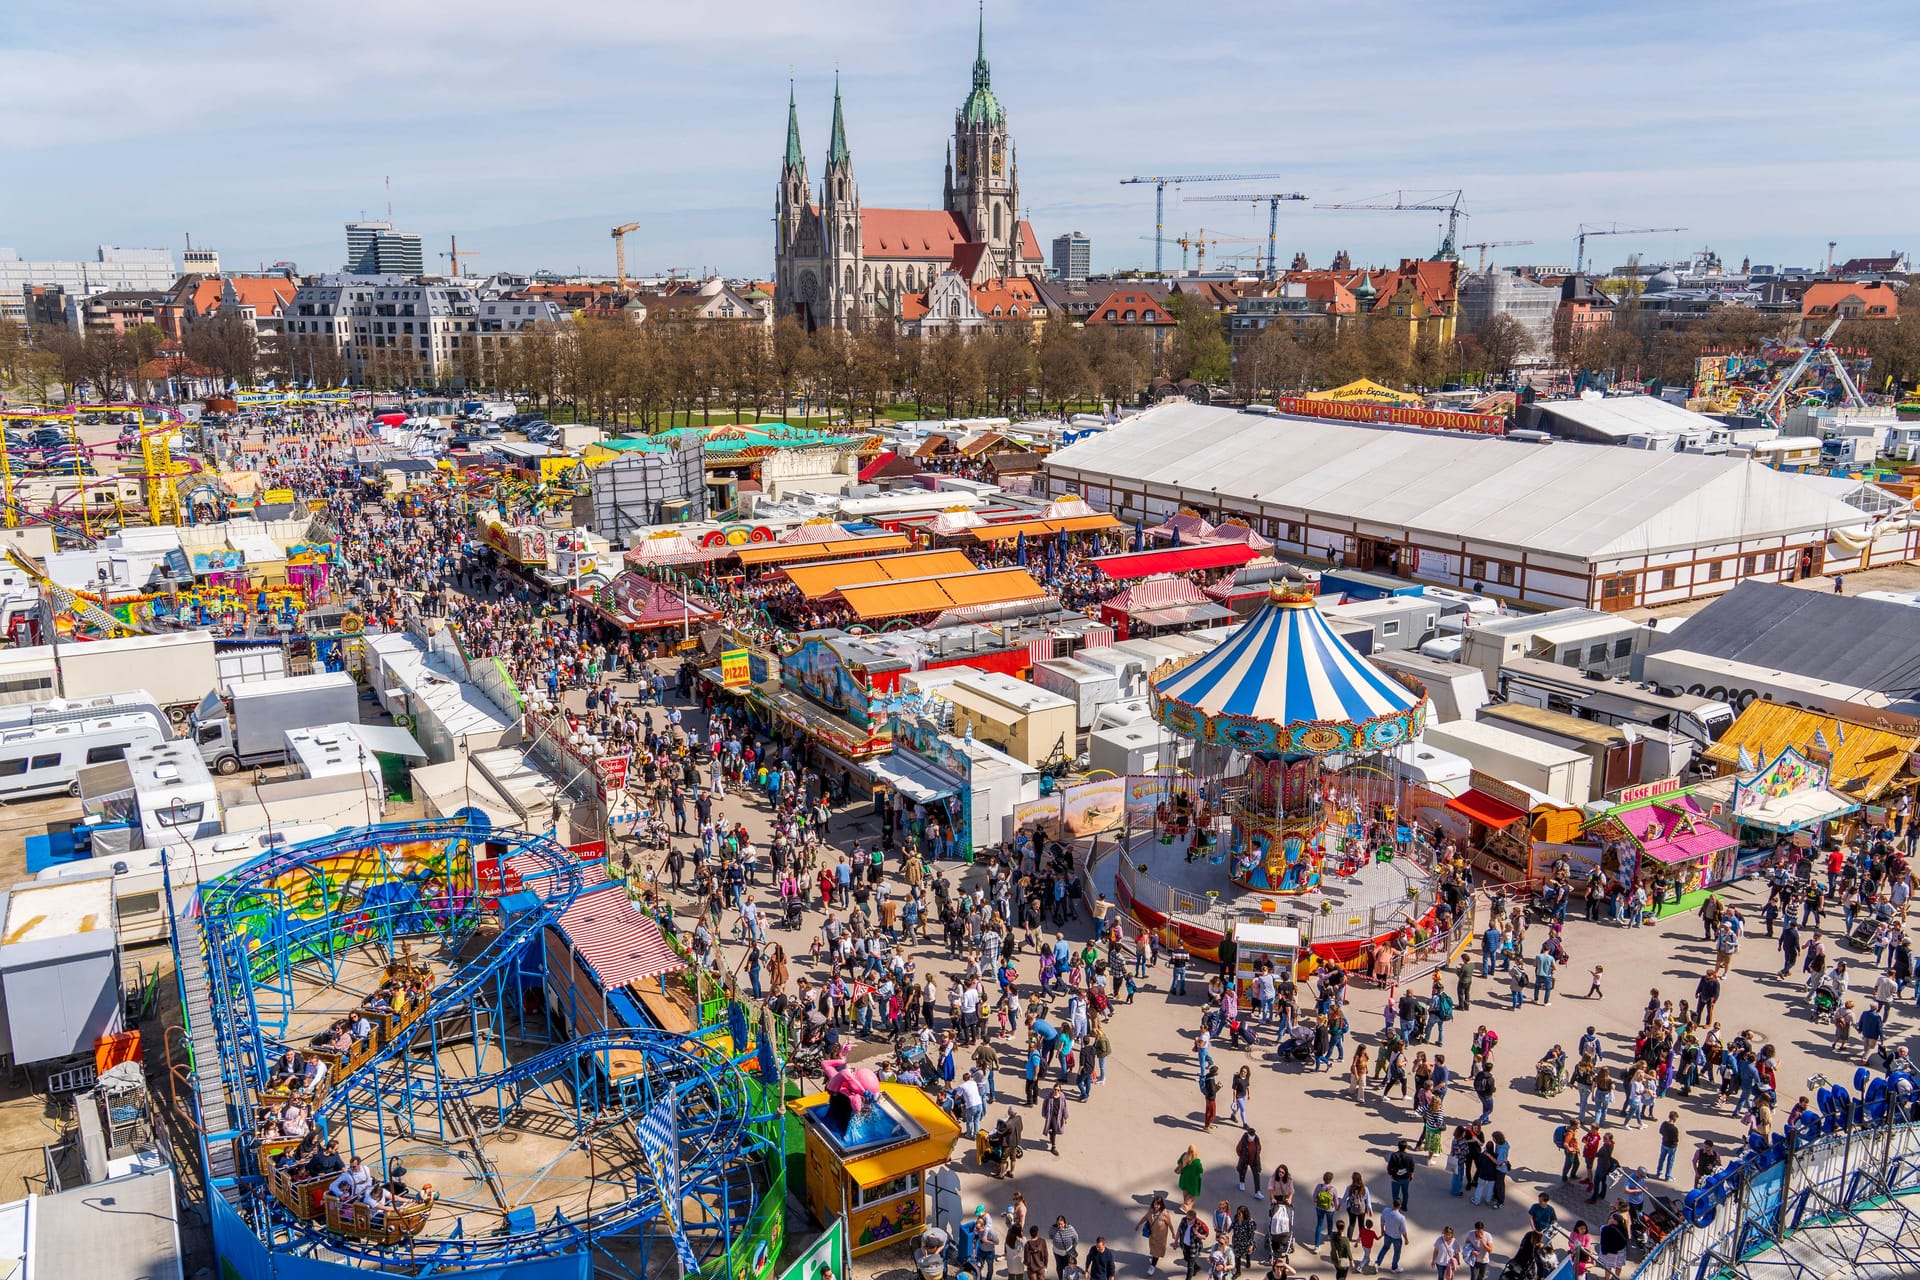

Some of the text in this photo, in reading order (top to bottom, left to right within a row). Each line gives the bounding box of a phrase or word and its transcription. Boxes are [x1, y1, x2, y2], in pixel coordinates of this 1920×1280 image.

[1333, 386, 1402, 401] Musik-Express
[1295, 397, 1482, 431] HIPPODROM HIPPODROM
[723, 665, 749, 681] PIZZA
[1623, 779, 1678, 802] SÜSSE HÜTTE
